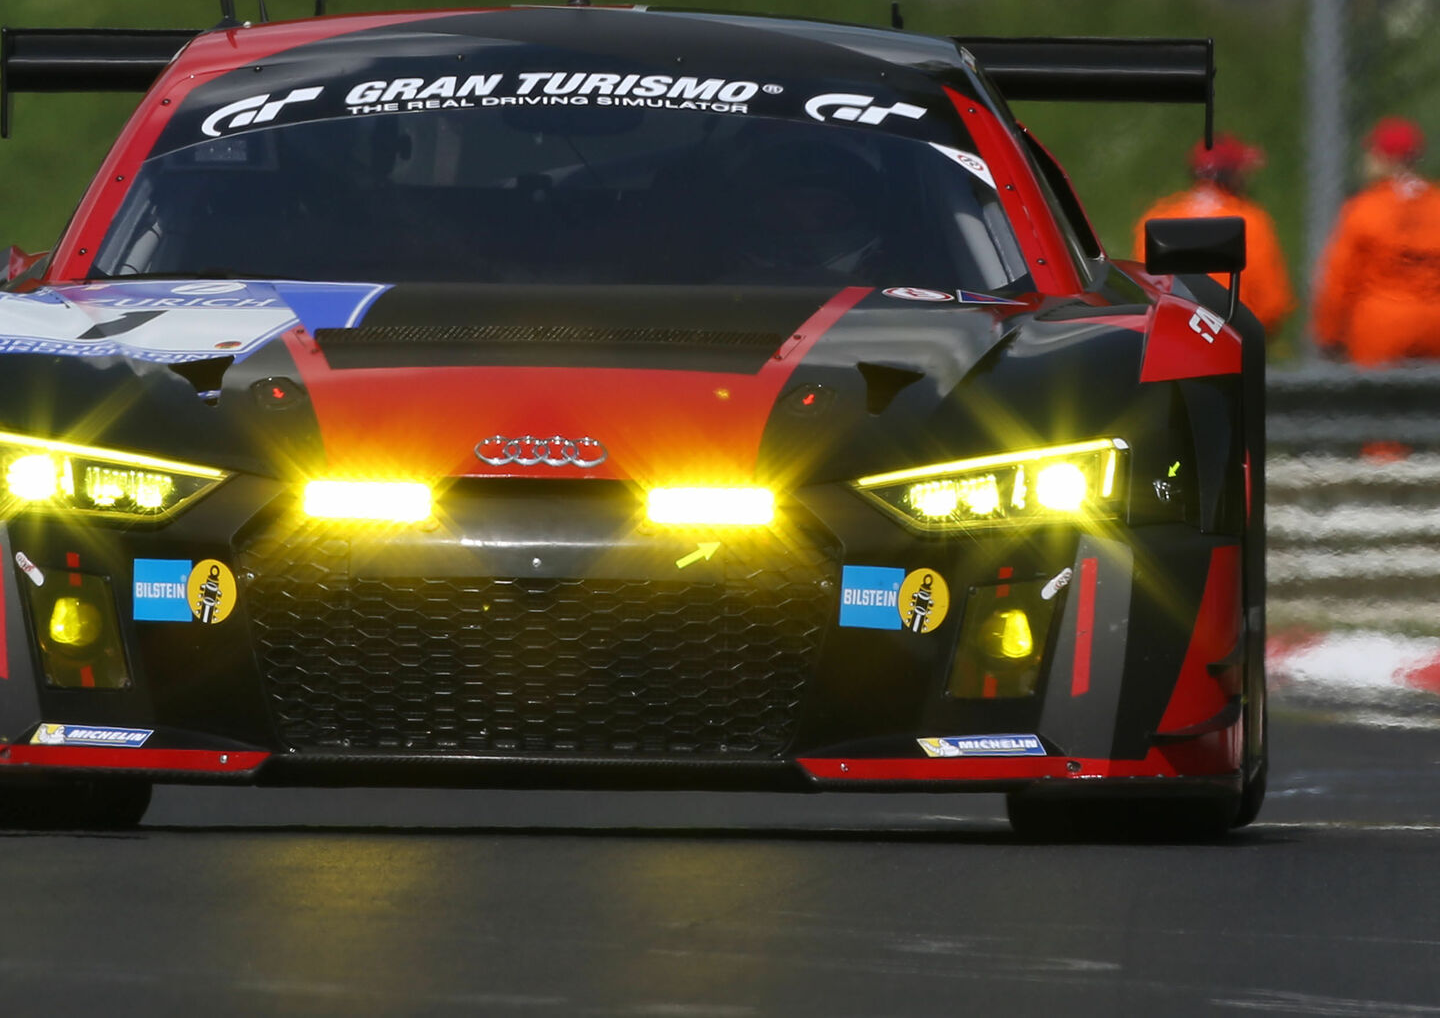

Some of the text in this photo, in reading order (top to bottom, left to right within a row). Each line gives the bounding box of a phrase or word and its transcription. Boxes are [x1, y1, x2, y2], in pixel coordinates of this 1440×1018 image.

[345, 71, 759, 105] GRAN TURISMO
[346, 95, 748, 116] THE REAL DRIVING SIMULATOR
[135, 582, 186, 599] BILSTEIN
[843, 588, 897, 607] BILSTEIN
[67, 729, 147, 741] MICHELIN
[958, 738, 1039, 749] MICHELIN
